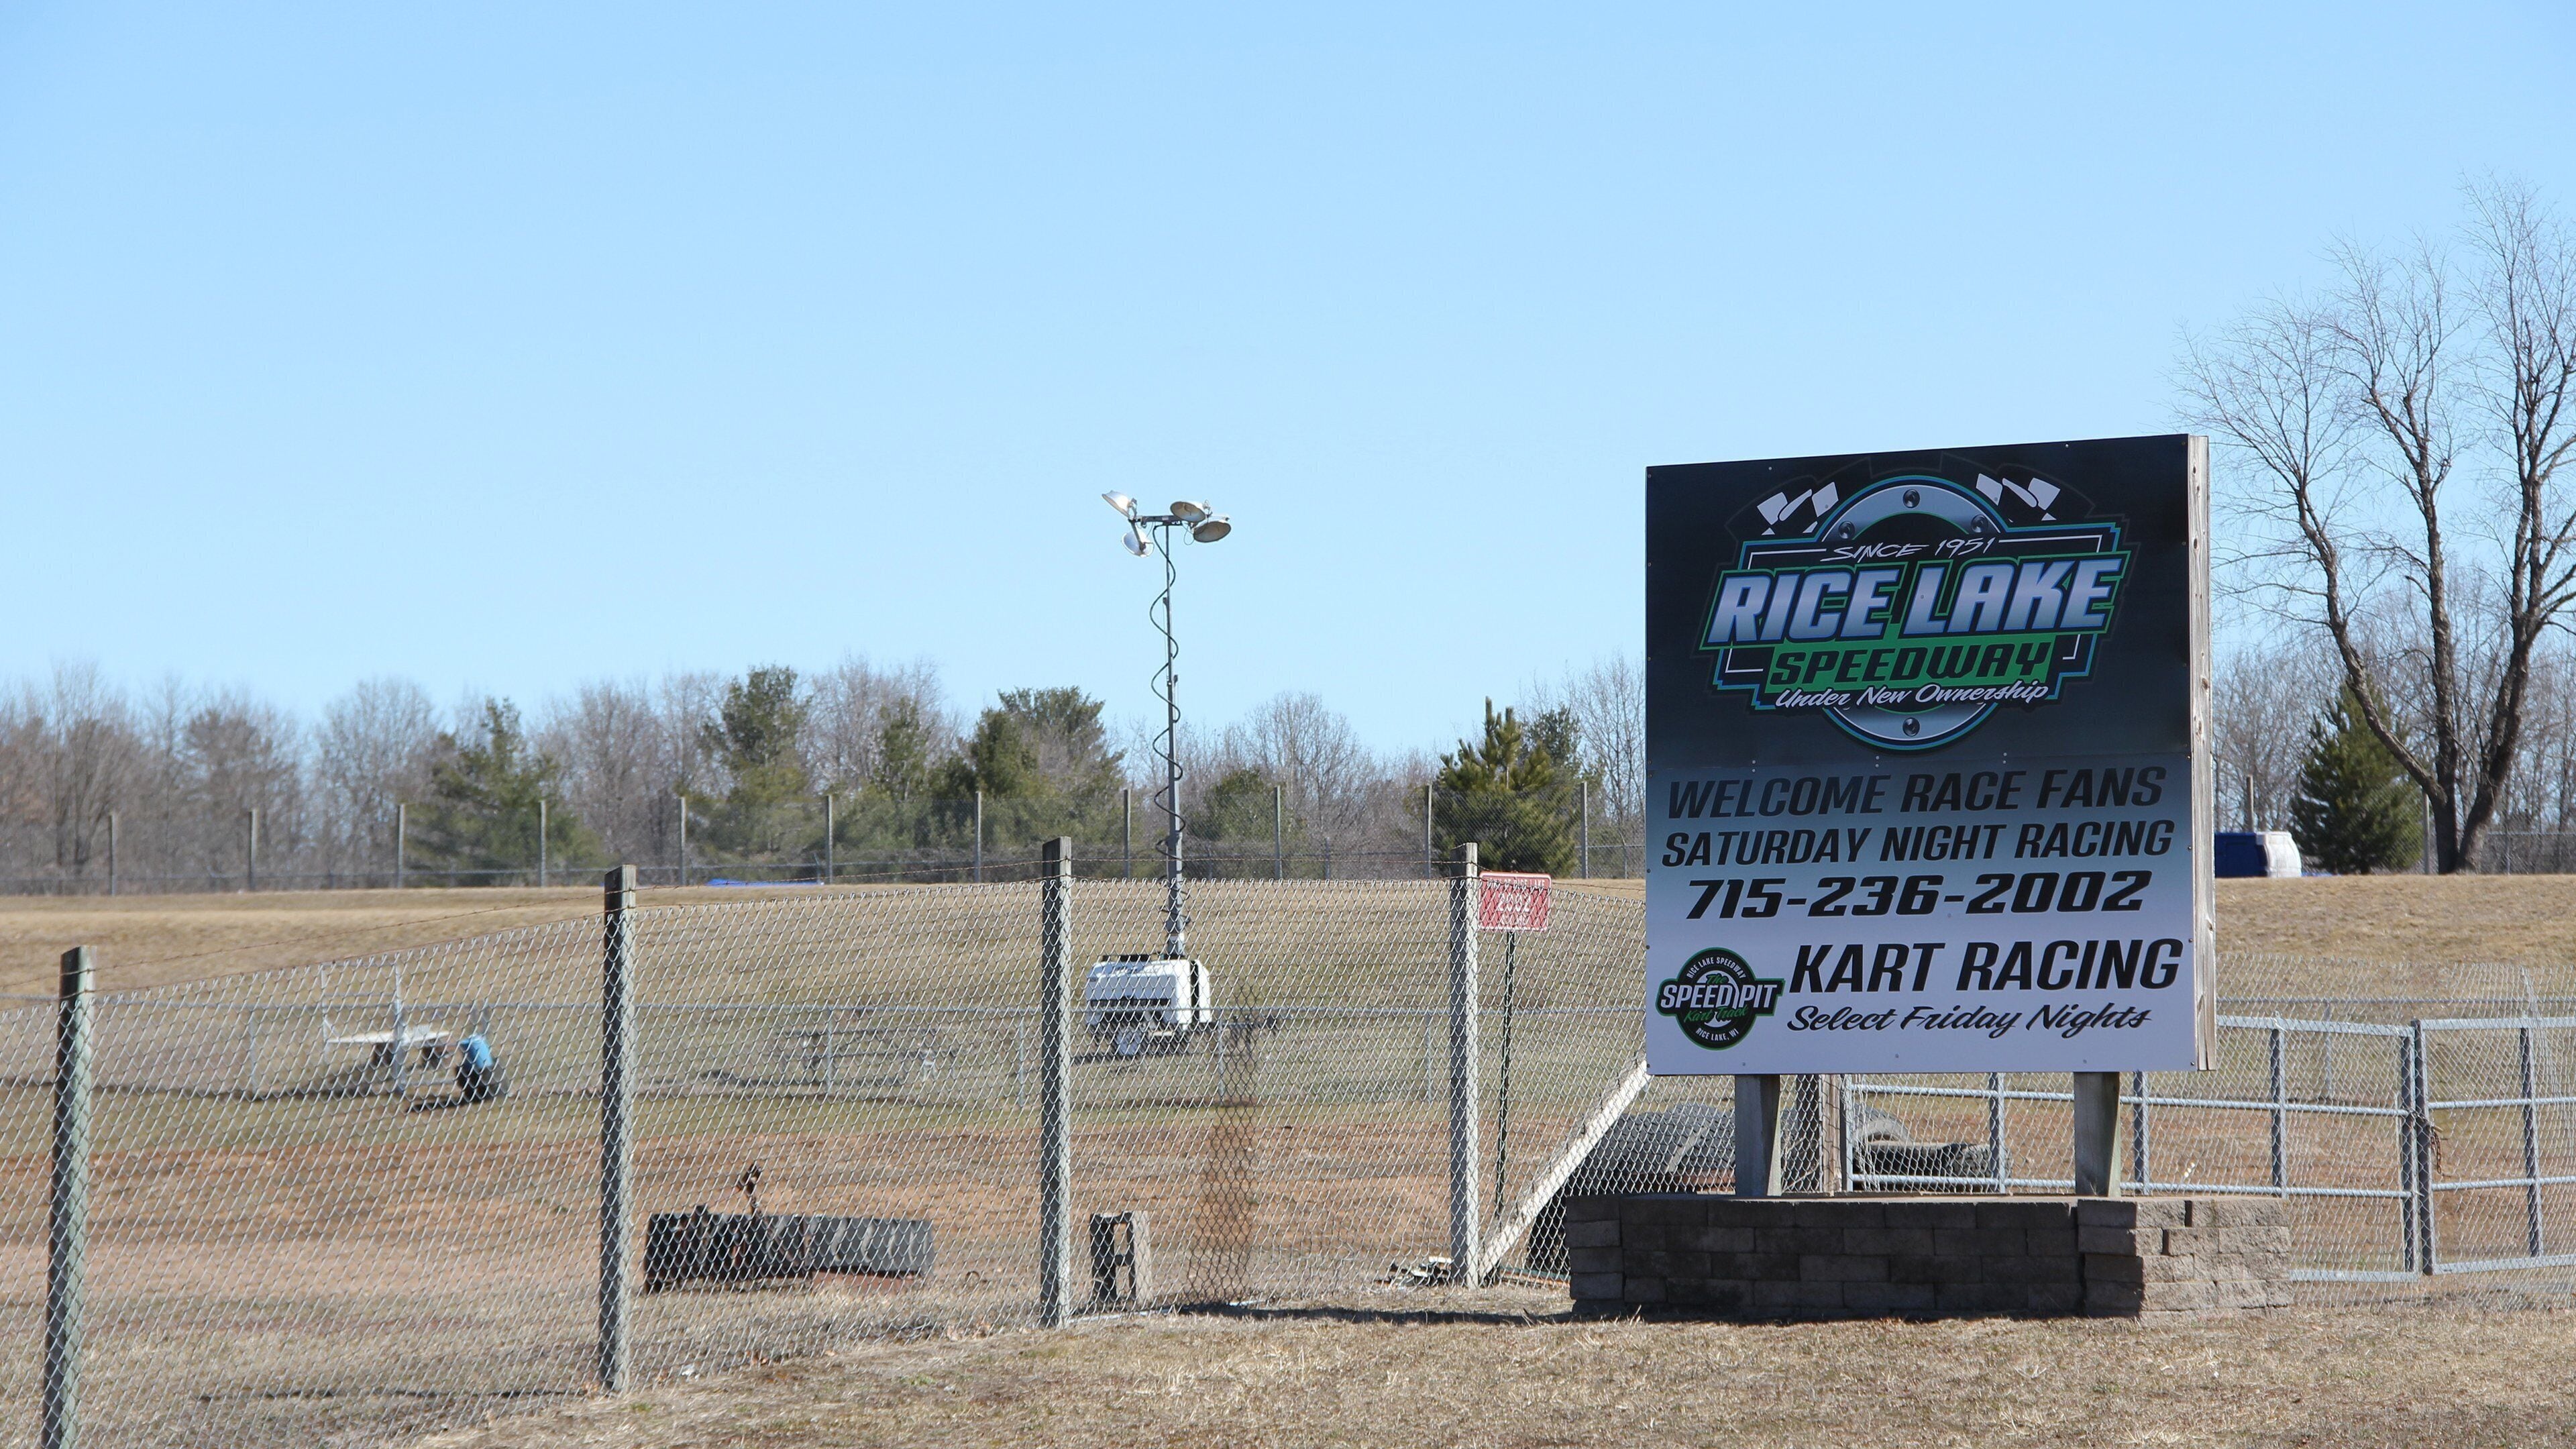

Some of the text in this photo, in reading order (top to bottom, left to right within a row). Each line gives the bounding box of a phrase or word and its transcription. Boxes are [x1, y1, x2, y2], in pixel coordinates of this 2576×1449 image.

[1820, 536, 1996, 563] SINCE 1951
[1707, 558, 2123, 644] RICE LAKE
[1769, 641, 2052, 687] SPEEDWAY
[1776, 680, 2049, 709] Under New Ownership
[1667, 765, 2167, 819] WELCOME RACE FANS
[1662, 818, 2176, 867] SATURDAY NIGHT RACING
[1685, 869, 2153, 920] 715-236-2002
[1686, 957, 1746, 979] RICE LAKE SPEEDWAY
[1707, 973, 1727, 984] The
[1788, 938, 2184, 994] KART RACING
[1684, 1006, 1749, 1023] Kart Track
[1787, 1002, 2152, 1039] Select Friday Nights
[1695, 1027, 1739, 1041] RICE LAKE, WI
